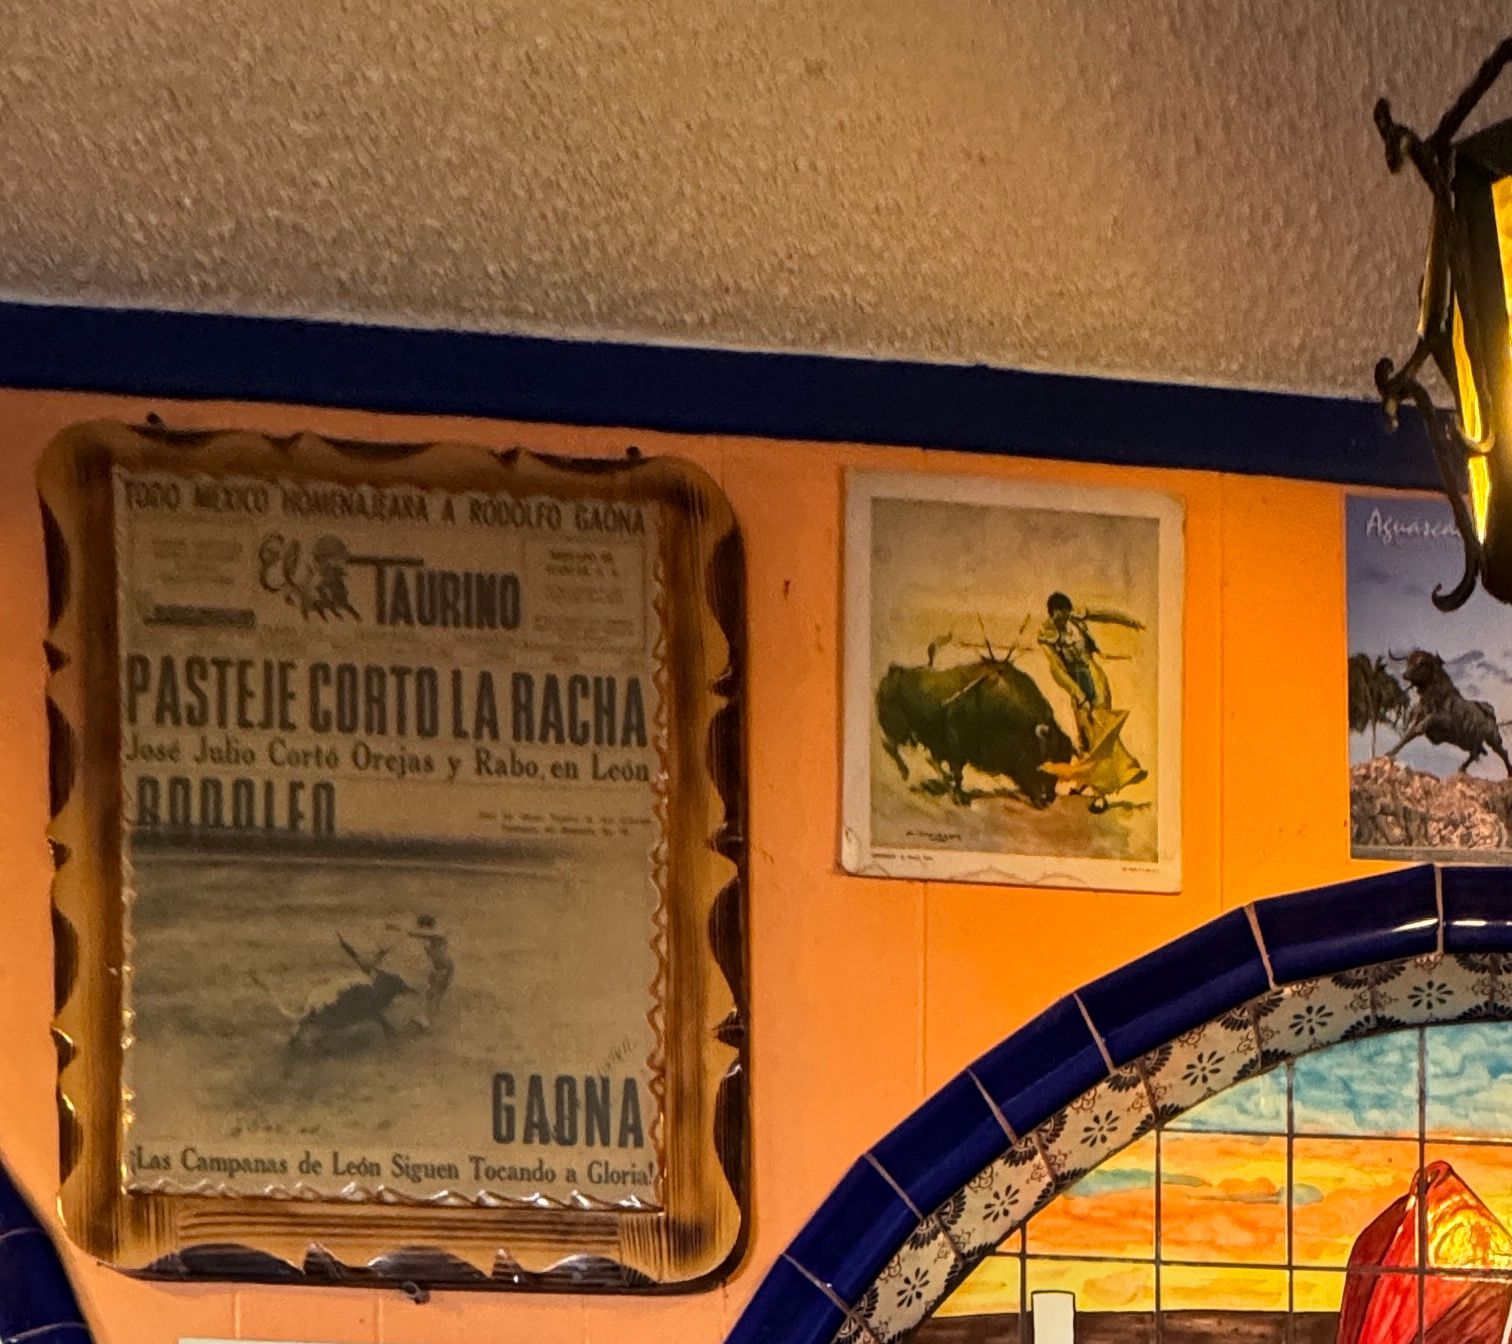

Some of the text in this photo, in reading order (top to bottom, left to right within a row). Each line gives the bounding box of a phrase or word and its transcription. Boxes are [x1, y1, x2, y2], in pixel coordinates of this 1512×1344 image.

[442, 502, 454, 524] A
[469, 497, 563, 531] RODOLFO
[575, 503, 646, 536] GAONA
[372, 556, 521, 630] TAURINO
[127, 654, 648, 748] PASTEJE CORTO LA RACHA
[194, 735, 255, 765] Julio
[353, 741, 435, 782] Orejas
[447, 755, 461, 783] y
[551, 760, 579, 780] en
[492, 1072, 645, 1149] GAONA
[181, 1147, 288, 1179] Campanas
[299, 1151, 322, 1175] de
[333, 1151, 381, 1178] León
[391, 1153, 460, 1184] Siguen
[469, 1154, 556, 1184] Tocando
[565, 1165, 577, 1179] a
[588, 1158, 655, 1186] Gloria!
